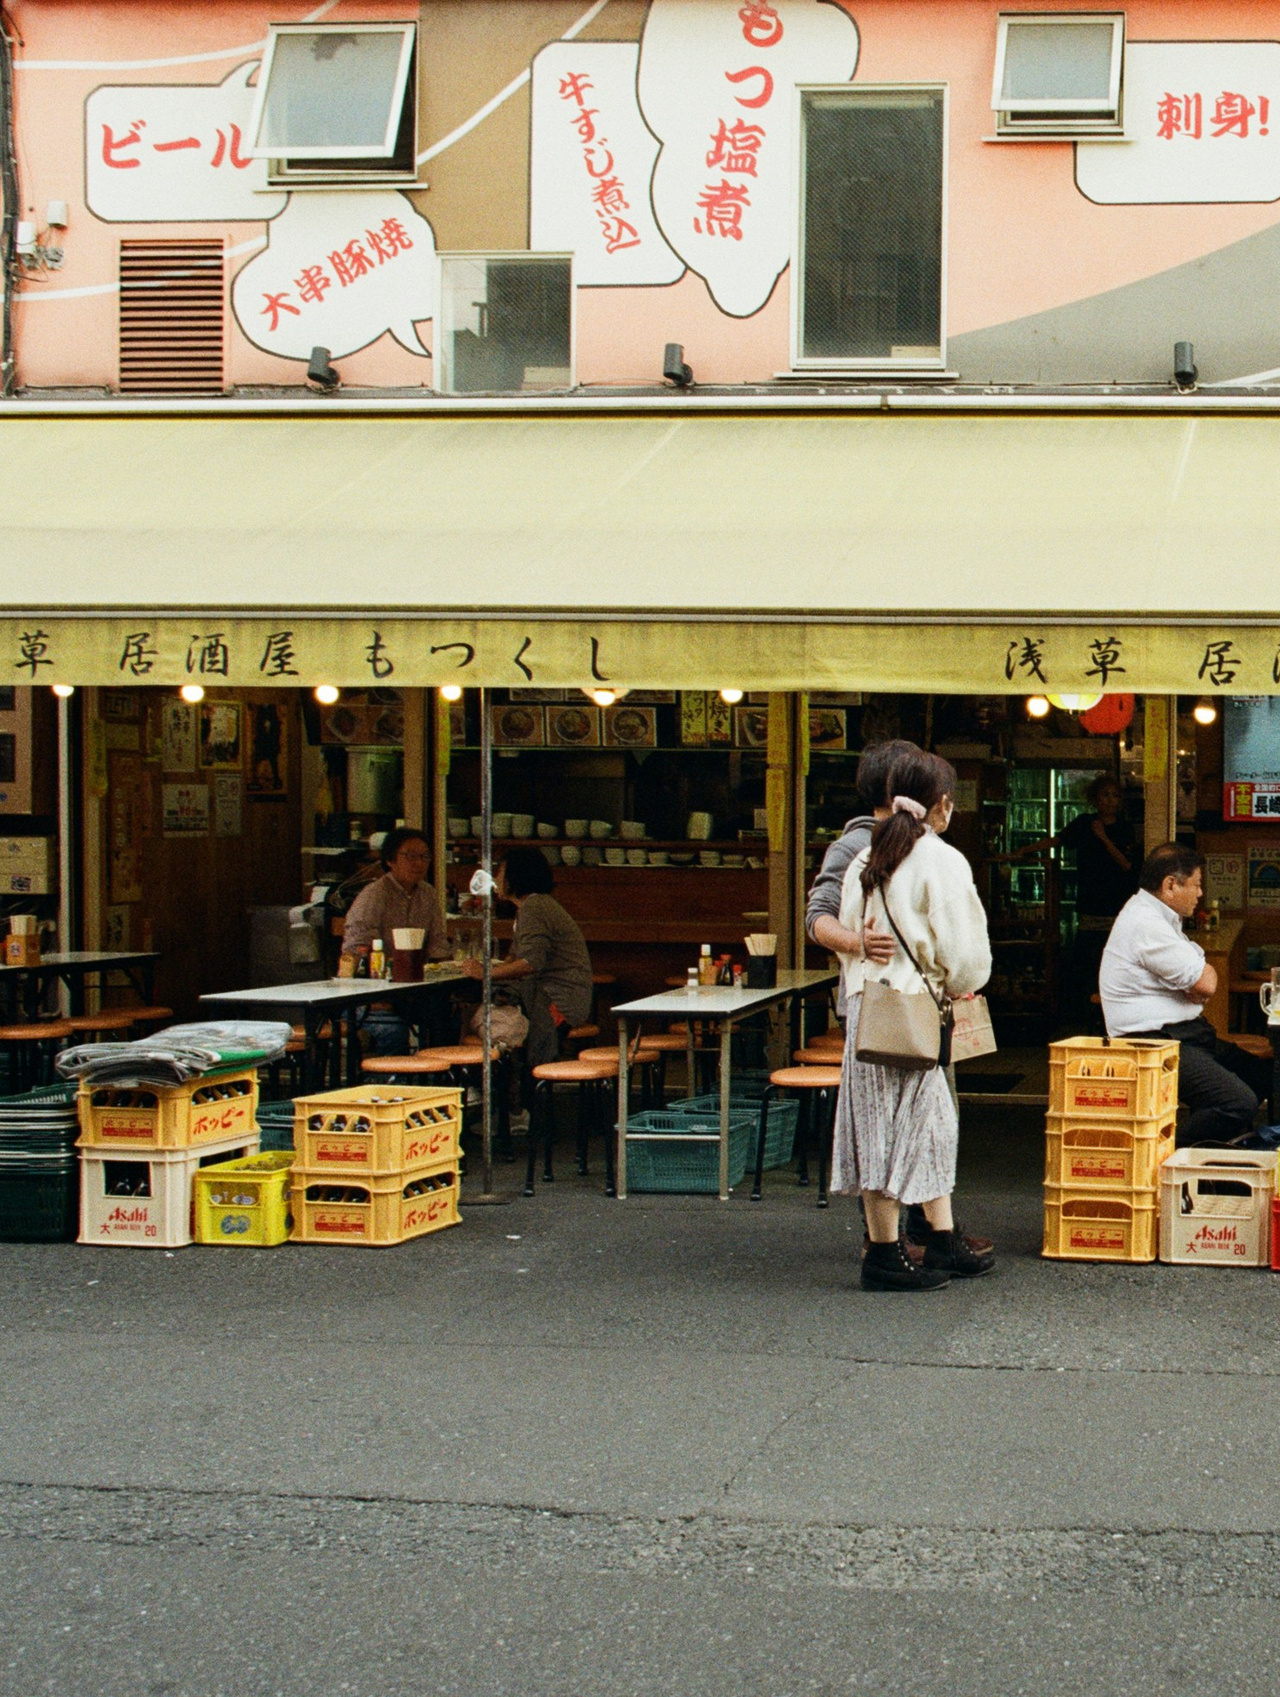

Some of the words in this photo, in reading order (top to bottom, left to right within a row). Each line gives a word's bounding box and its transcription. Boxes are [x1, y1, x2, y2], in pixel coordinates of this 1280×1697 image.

[693, 0, 784, 242] もつ塩煮
[1156, 91, 1270, 140] 刺身!
[101, 119, 253, 170] ビール
[557, 72, 642, 255] 牛すじ煮込
[260, 217, 414, 332] 大串豚焼
[14, 629, 54, 678] 草
[119, 631, 299, 678] 居酒屋
[365, 630, 612, 682] もつくし
[1004, 637, 1127, 687] 浅草
[193, 1107, 245, 1135] ホッピー
[405, 1131, 450, 1160] ホッピー
[100, 1223, 110, 1235] 大
[109, 1207, 148, 1222] Asahi
[404, 1199, 448, 1230] ホッピー
[145, 1225, 156, 1237] 20
[1195, 1224, 1237, 1241] Asahi
[1185, 1242, 1197, 1254] 大
[1233, 1244, 1246, 1256] 20
